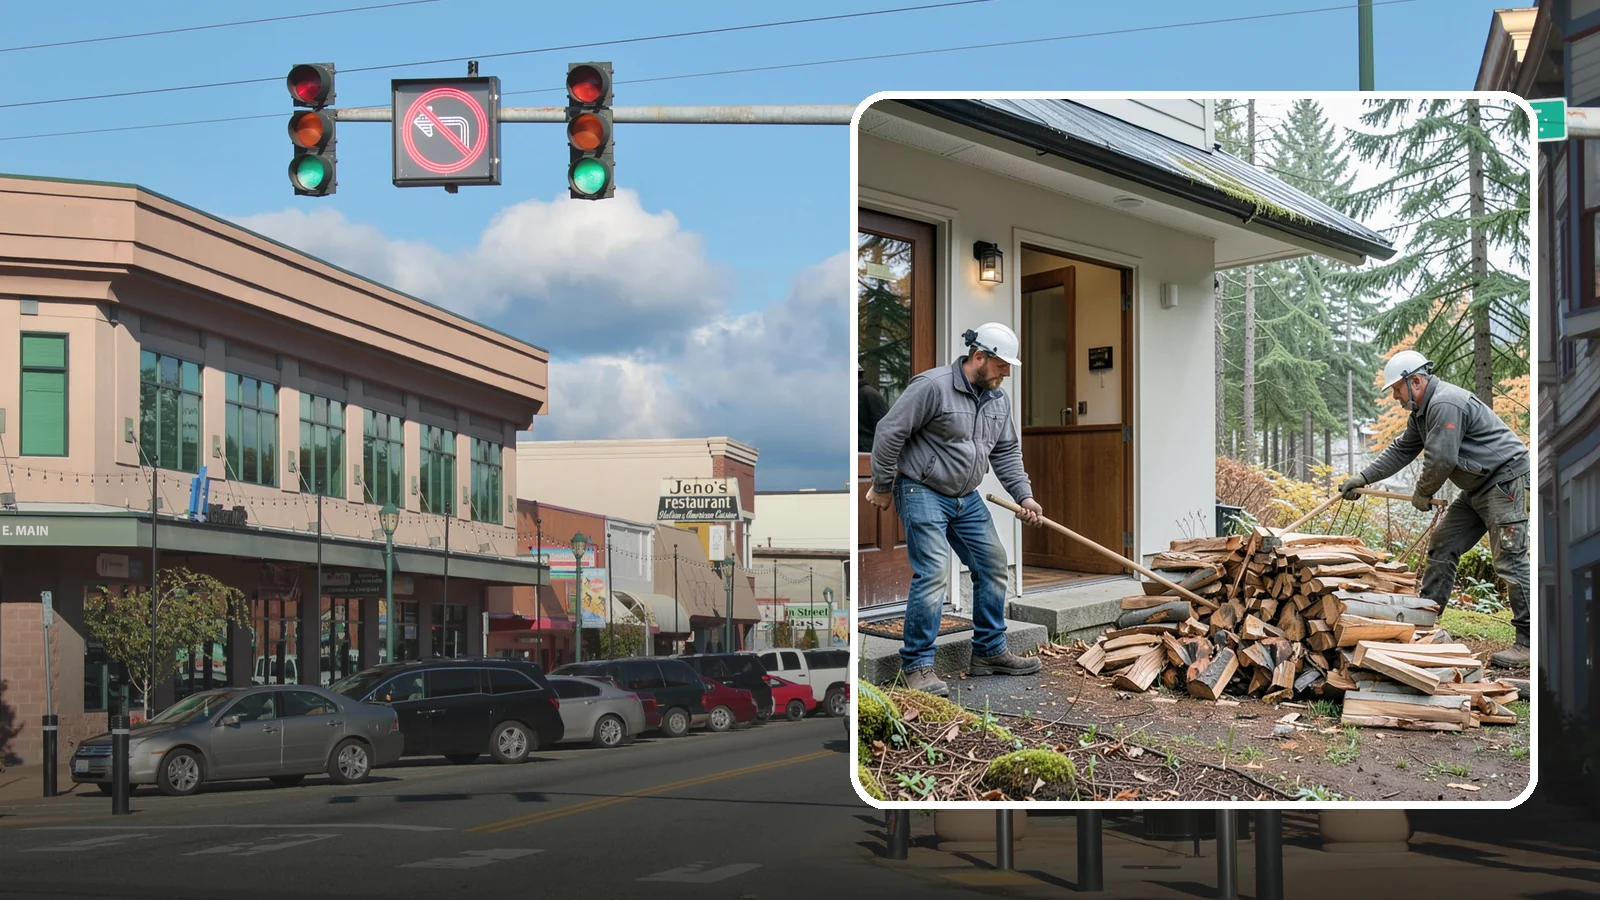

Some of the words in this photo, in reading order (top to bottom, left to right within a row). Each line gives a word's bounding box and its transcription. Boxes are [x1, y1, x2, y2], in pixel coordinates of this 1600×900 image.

[669, 480, 728, 494] Jeno's
[665, 496, 731, 509] restaurant
[658, 510, 682, 519] Italian
[686, 510, 715, 519] American
[715, 510, 737, 519] Cuisine
[2, 525, 13, 536] E.
[15, 525, 49, 536] MAIN
[797, 608, 828, 617] Street
[790, 619, 823, 627] lass
